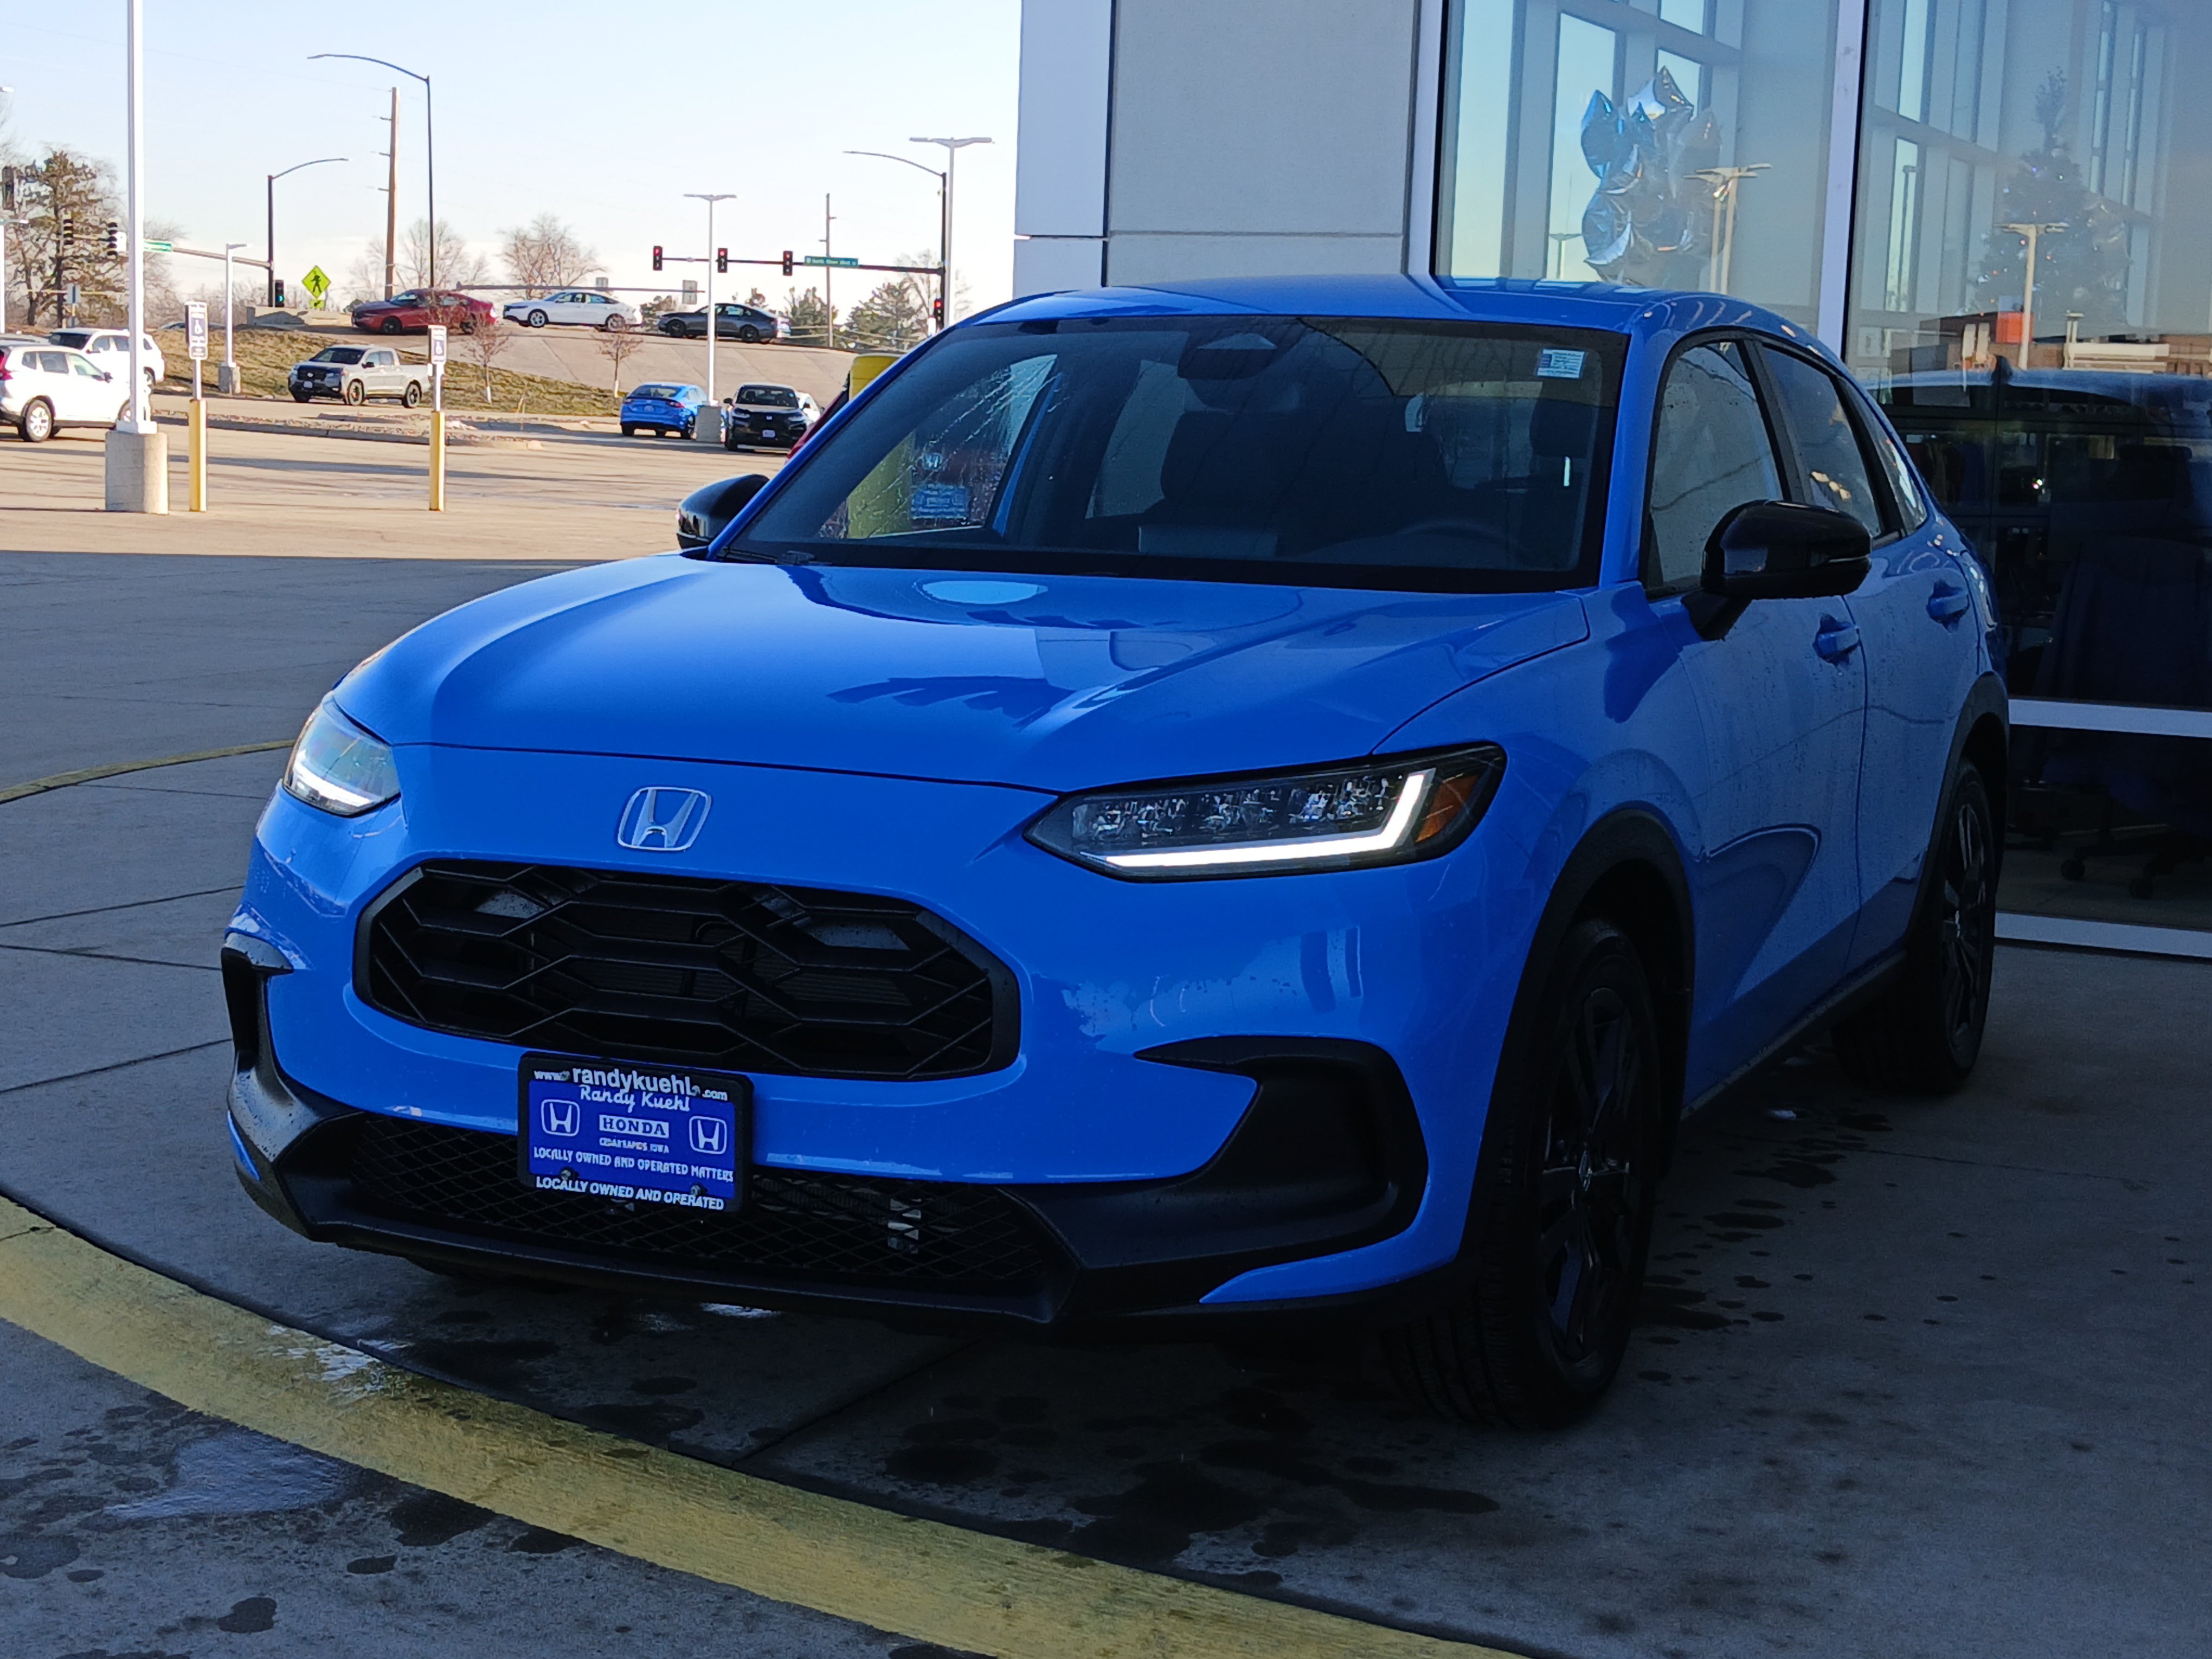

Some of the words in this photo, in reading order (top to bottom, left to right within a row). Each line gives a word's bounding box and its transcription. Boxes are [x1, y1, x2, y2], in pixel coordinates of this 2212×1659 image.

[580, 1084, 635, 1113] Randy
[641, 1092, 690, 1111] Kuehl
[603, 1117, 666, 1136] HONDA
[533, 1147, 572, 1163] LOCALLY
[576, 1153, 611, 1166] OWNED
[614, 1156, 634, 1168] AND
[638, 1160, 688, 1175] OPERATED
[691, 1165, 734, 1182] MATTERS
[536, 1176, 588, 1194] LOCALLY
[590, 1182, 634, 1199] OWNED
[636, 1188, 661, 1202] AND
[664, 1191, 724, 1211] OPERATED
